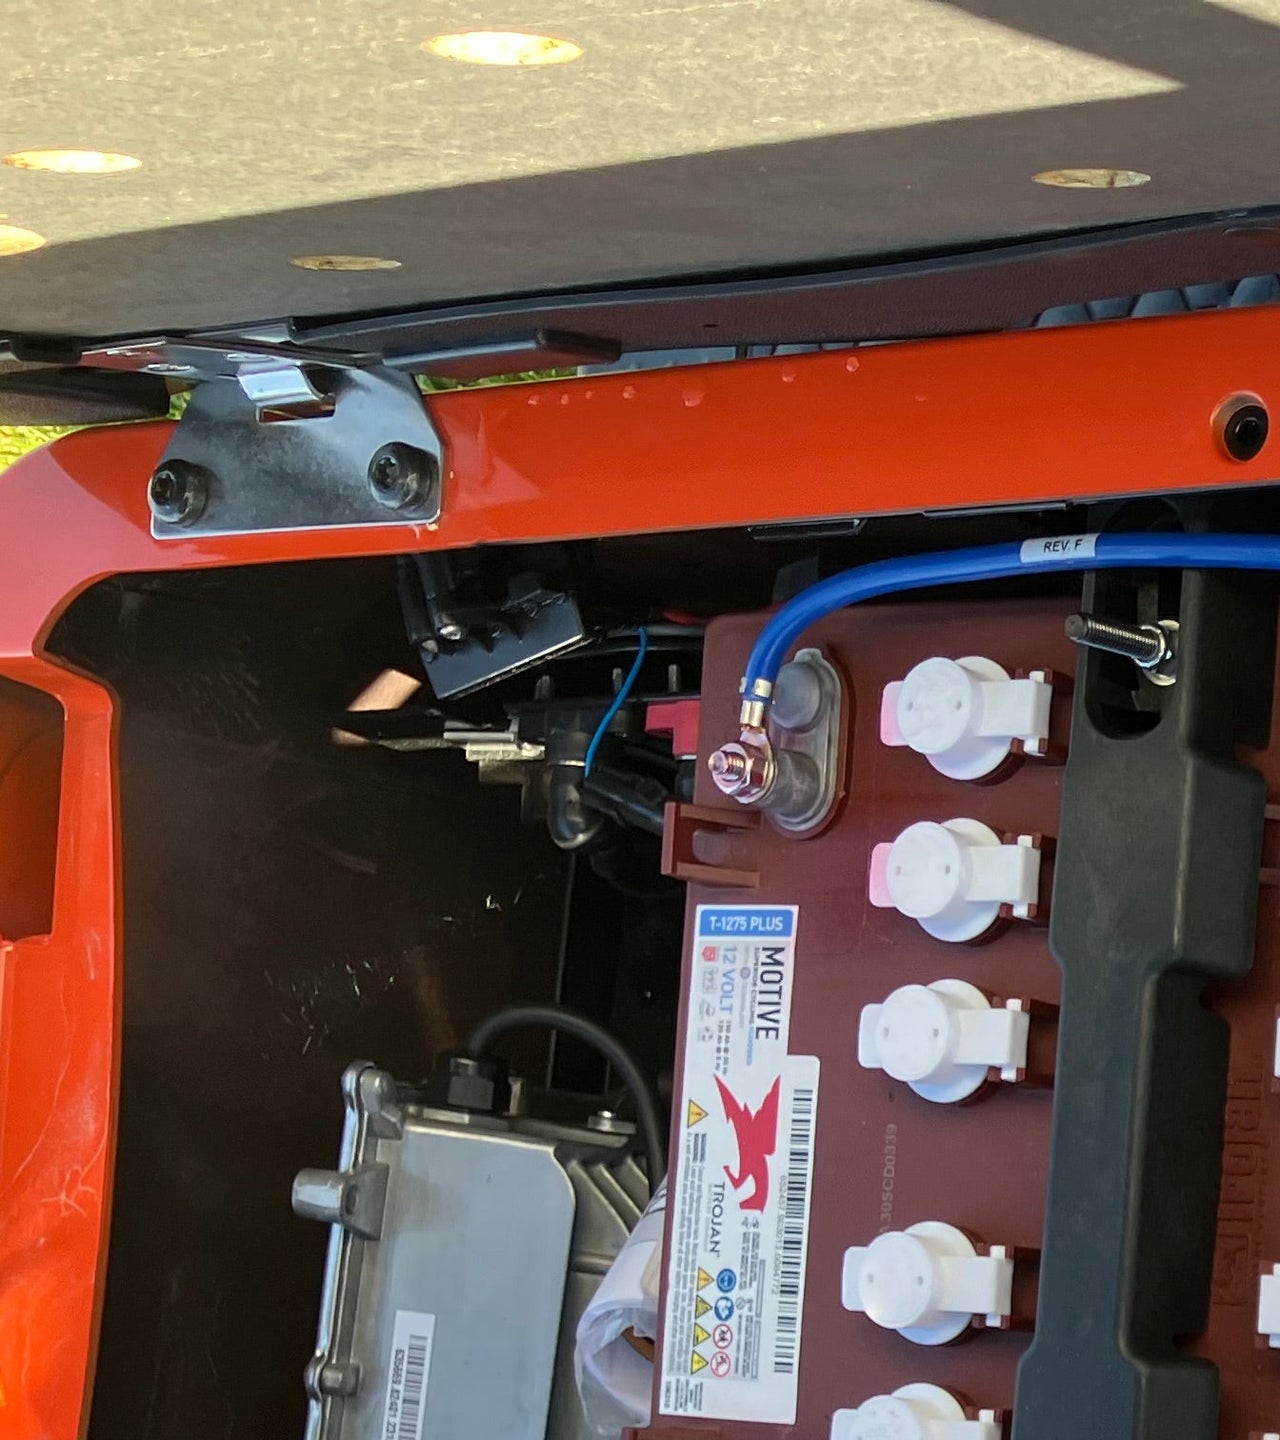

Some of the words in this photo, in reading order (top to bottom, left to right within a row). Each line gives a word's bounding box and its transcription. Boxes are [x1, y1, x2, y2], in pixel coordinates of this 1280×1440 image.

[1043, 540, 1071, 553] REV.
[1074, 539, 1083, 550] F
[709, 915, 747, 931] T-1275
[749, 915, 784, 931] PLUS
[722, 946, 737, 964] 12
[719, 968, 736, 1015] VOLT
[755, 946, 786, 1041] MOTIVE
